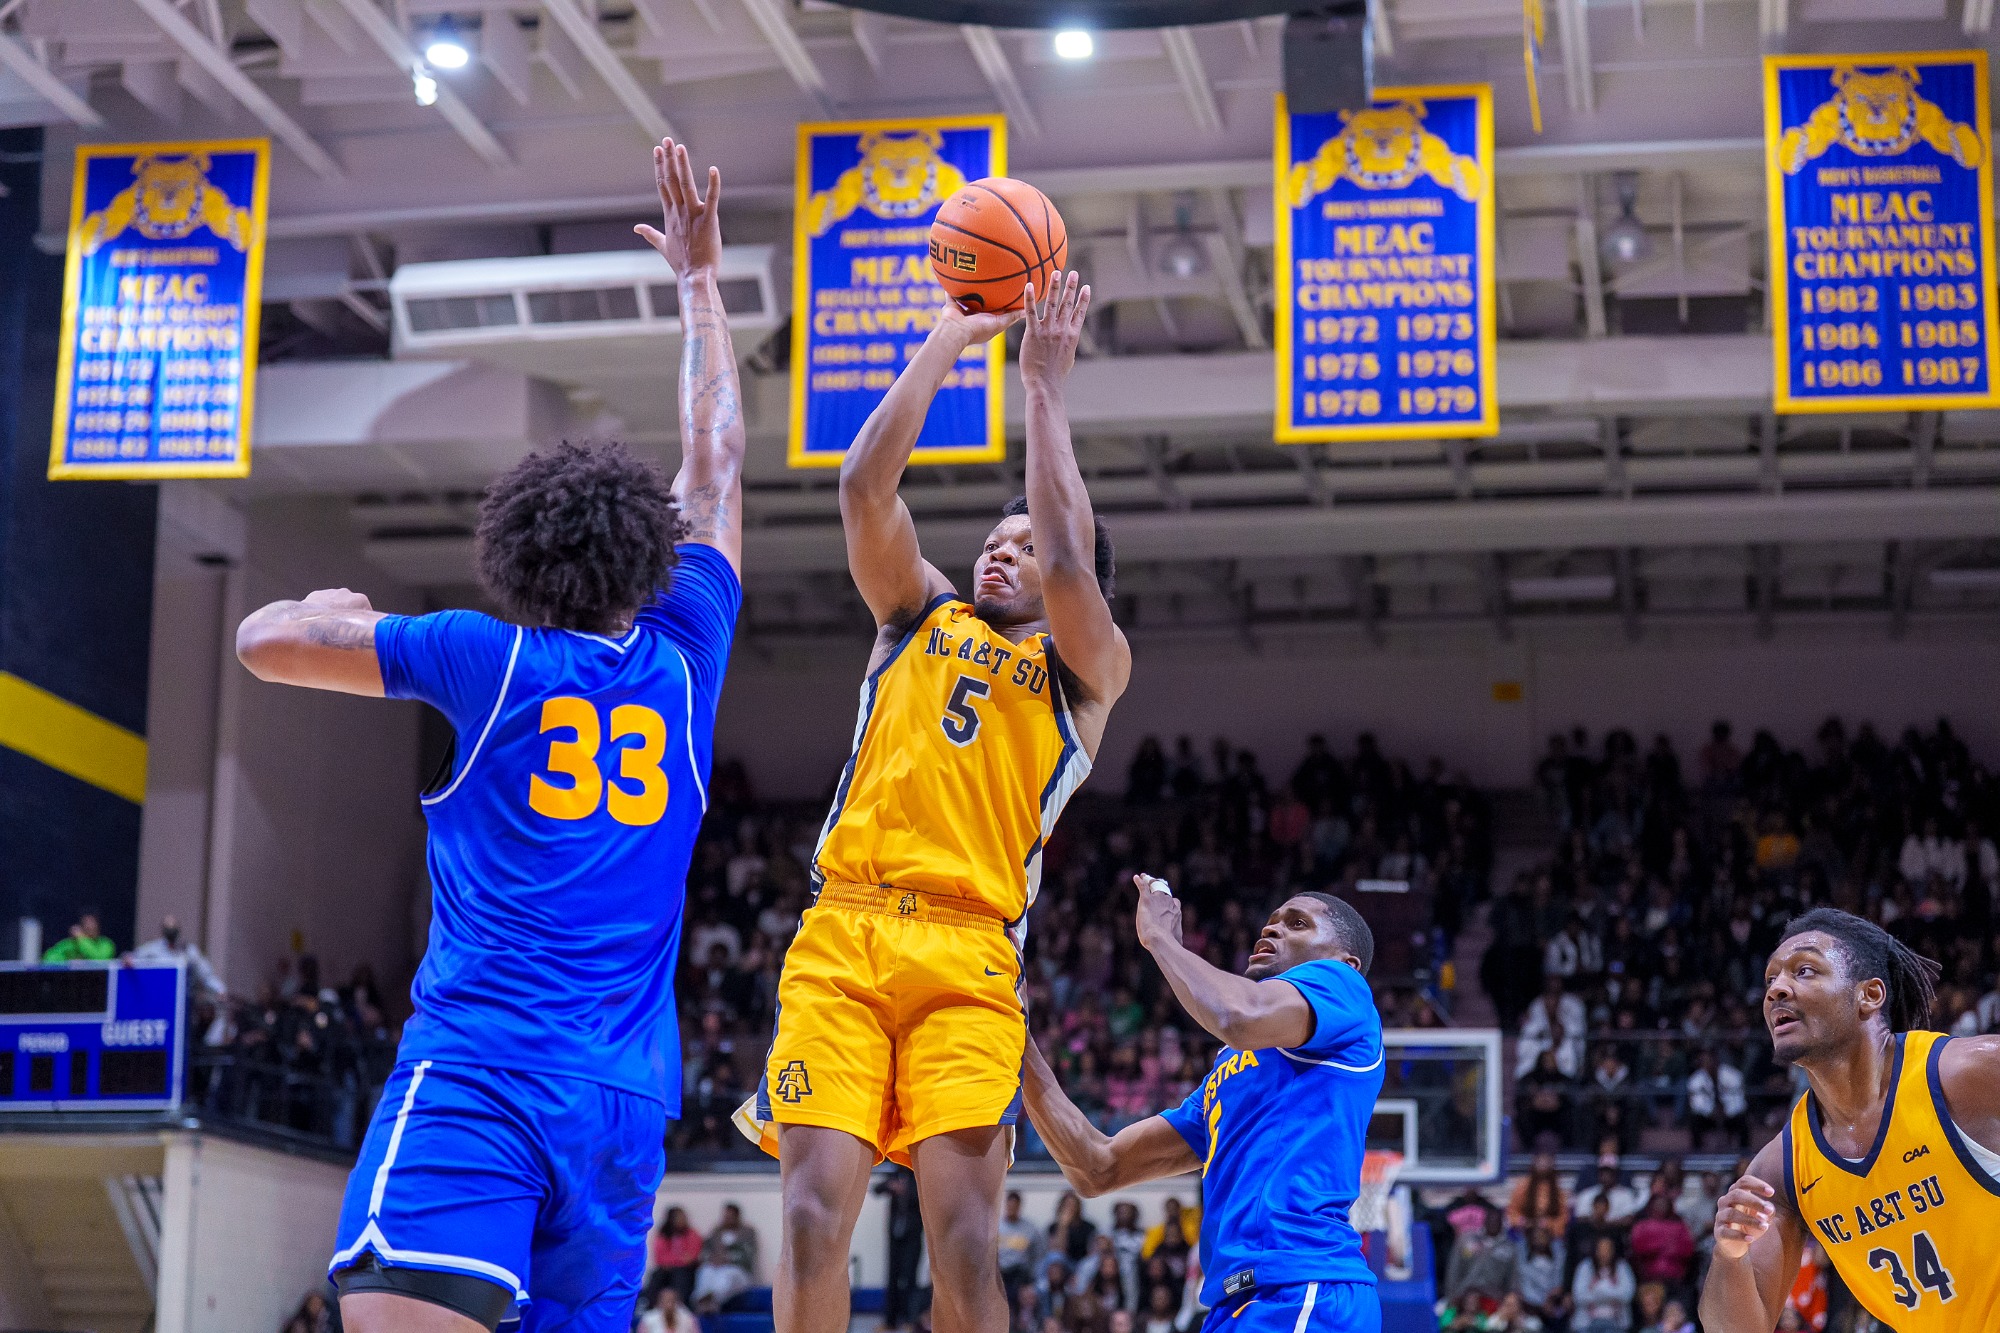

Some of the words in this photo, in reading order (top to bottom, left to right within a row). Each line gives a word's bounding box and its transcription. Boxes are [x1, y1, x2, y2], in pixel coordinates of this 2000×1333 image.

[1863, 165, 1943, 184] BASKETBALL
[1830, 191, 1934, 224] MEAC
[1333, 223, 1435, 254] MEAC
[1793, 222, 1974, 252] TOURNAMENT
[929, 239, 976, 273] ELITE
[1297, 254, 1473, 282] TOURNAMENT
[1794, 249, 1977, 280] CHAMPIONS
[119, 274, 209, 304] MEAC
[1297, 281, 1474, 311] CHAMPIONS
[1801, 286, 1879, 314] 1982
[1900, 283, 1978, 312] 1983
[80, 324, 239, 353] CHAMPIONS
[1303, 316, 1380, 345] 1972
[1397, 313, 1474, 341] 1973
[1802, 322, 1880, 351] 1984
[1900, 320, 1979, 349] 1985
[1303, 353, 1381, 381] 1975
[1398, 349, 1475, 378] 1976
[1803, 359, 1883, 388] 1986
[1902, 357, 1980, 386] 1987
[1303, 389, 1382, 418] 1978
[1398, 385, 1477, 416] 1979
[925, 627, 954, 657] NC
[957, 637, 1012, 676] A&T
[1011, 658, 1048, 695] SU
[940, 673, 991, 748] 5
[528, 696, 669, 826] 33
[18, 1032, 69, 1053] PERIOD
[101, 1018, 168, 1046] GUEST
[1903, 1144, 1930, 1163] CAA
[1816, 1213, 1852, 1244] NC
[1854, 1190, 1906, 1236] A&T
[1907, 1174, 1945, 1213] SU
[1242, 1274, 1250, 1284] M
[1867, 1230, 1958, 1312] 34
